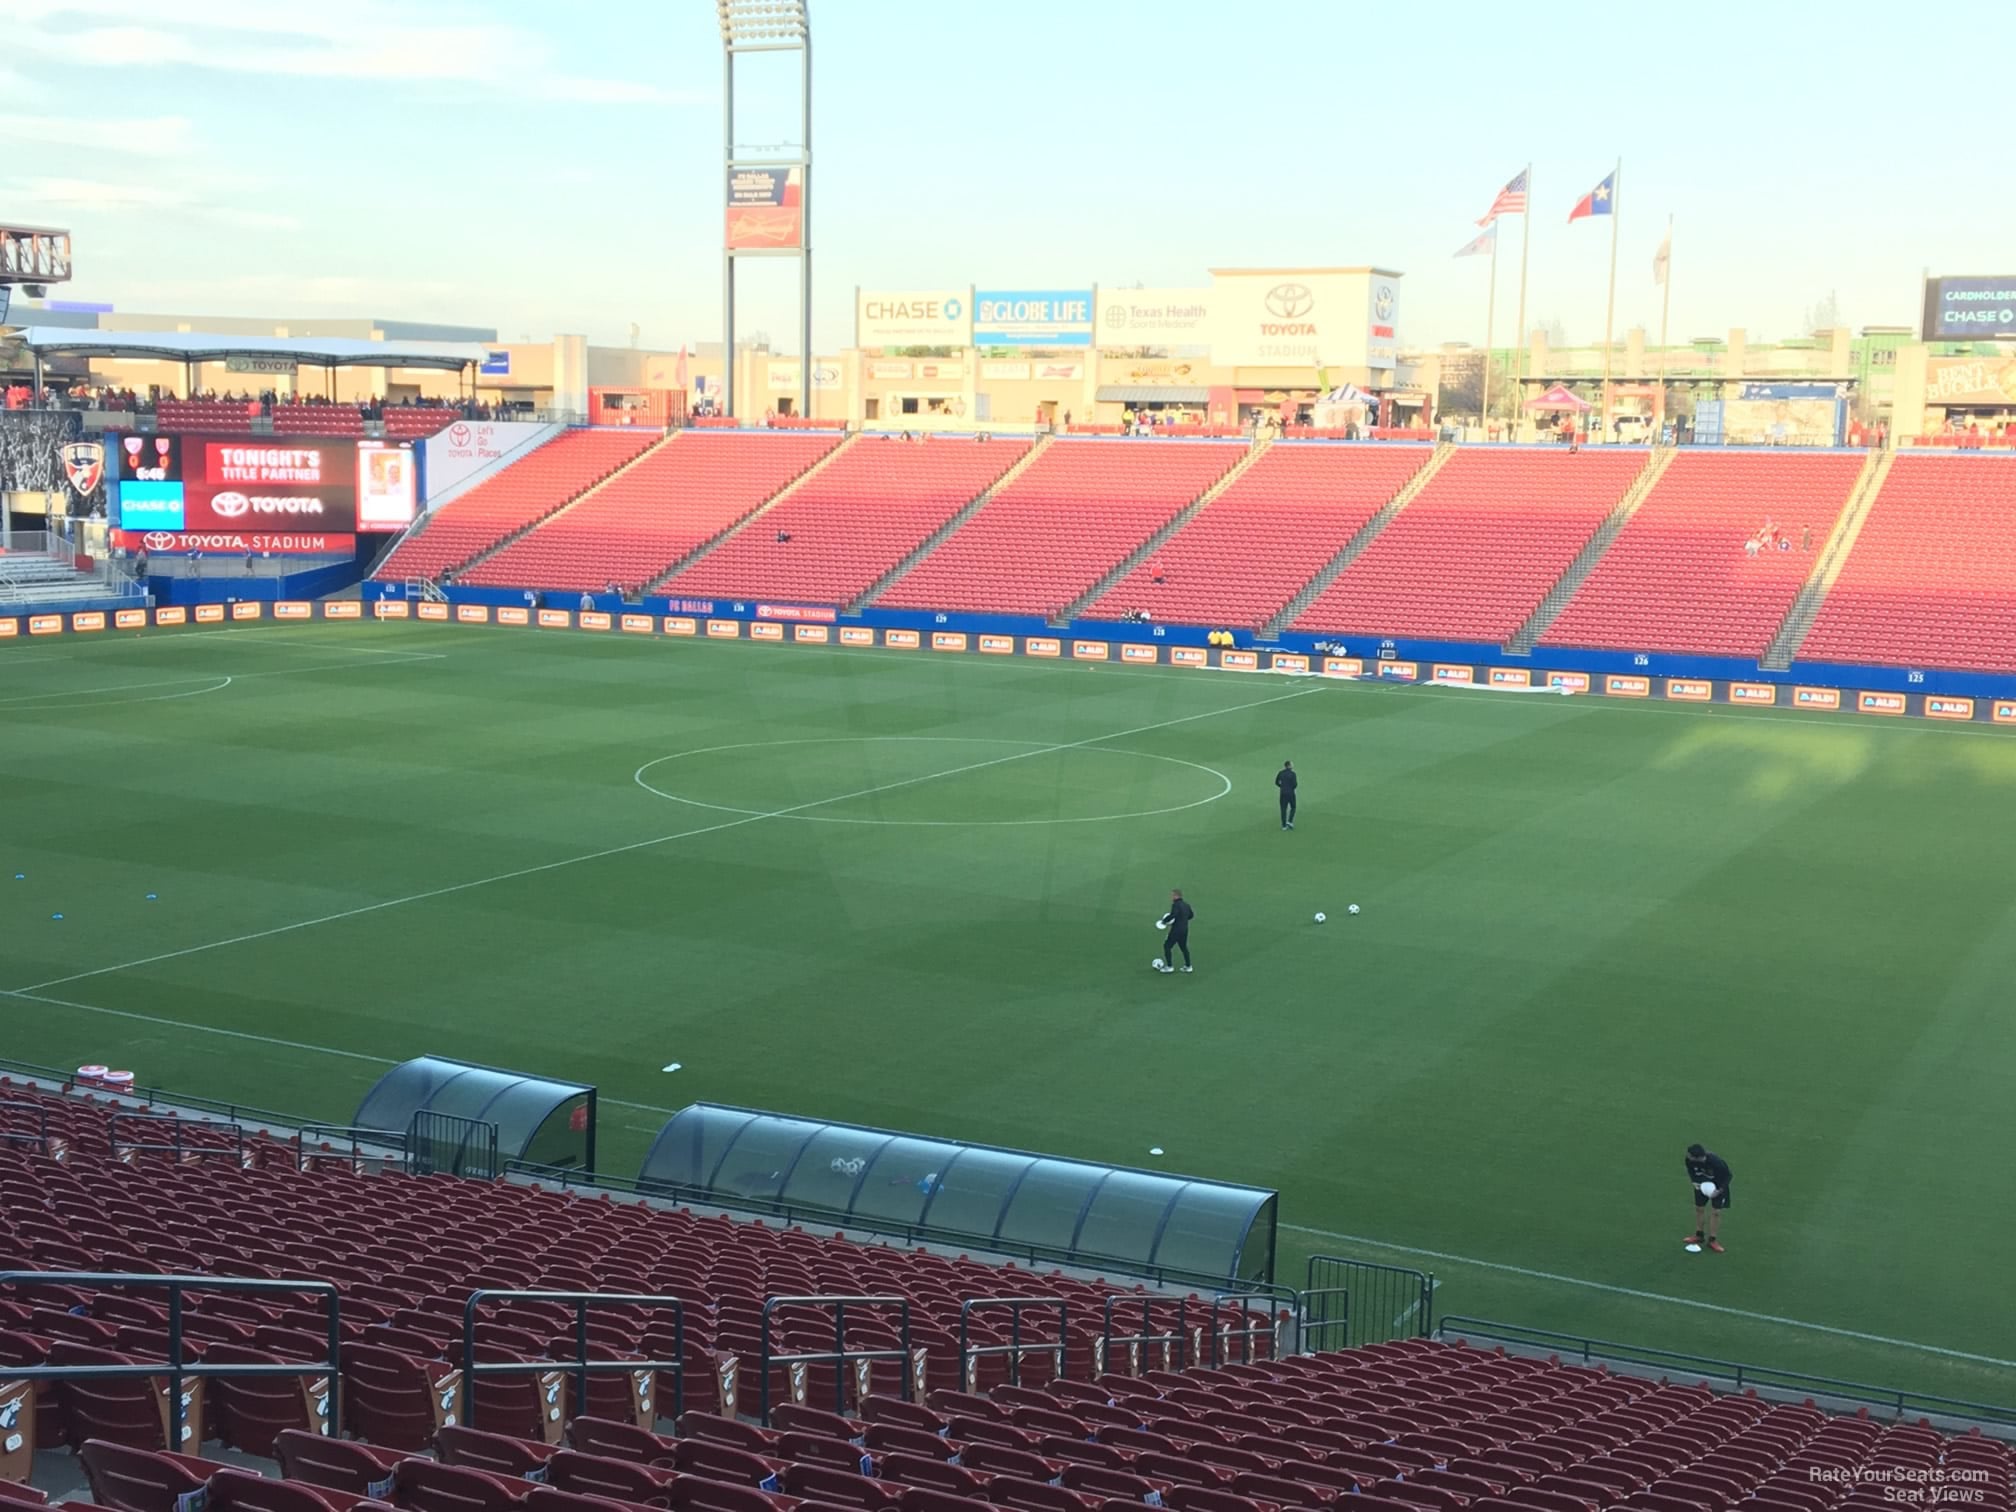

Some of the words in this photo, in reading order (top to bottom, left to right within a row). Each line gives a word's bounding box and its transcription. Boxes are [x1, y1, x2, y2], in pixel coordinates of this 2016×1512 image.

[865, 301, 939, 320] CHASE
[993, 301, 1049, 321] GLOBE
[1053, 301, 1086, 321] LIFE
[1129, 305, 1163, 317] Texas
[1166, 305, 1207, 317] Health
[1944, 310, 1997, 322] CHASE
[1260, 323, 1317, 336] TOYOTA
[1258, 345, 1317, 358] STADIUM
[252, 361, 297, 370] TOYOTA
[220, 449, 321, 467] TONIGHT'S
[221, 467, 258, 480] TITLE
[261, 467, 321, 481] PARTNER
[250, 498, 322, 514] TOYOTA
[252, 535, 324, 549] STADIUM
[773, 608, 801, 618] TOYOTA
[1234, 655, 1253, 663] ALDI
[1285, 659, 1305, 667] ALDI
[1337, 662, 1358, 670] ALDI
[1392, 665, 1413, 674] ALDI
[1447, 669, 1468, 677] ALDI
[1504, 673, 1526, 682] ALDI
[1562, 677, 1584, 686] ALDI
[1907, 674, 1925, 683] 125
[1621, 682, 1644, 691] ALDI
[1683, 684, 1706, 693] ALDI
[1745, 689, 1770, 699] ALDI
[1810, 693, 1835, 704] ALDI
[1875, 698, 1900, 709] ALDI
[1942, 702, 1967, 713] ALDI
